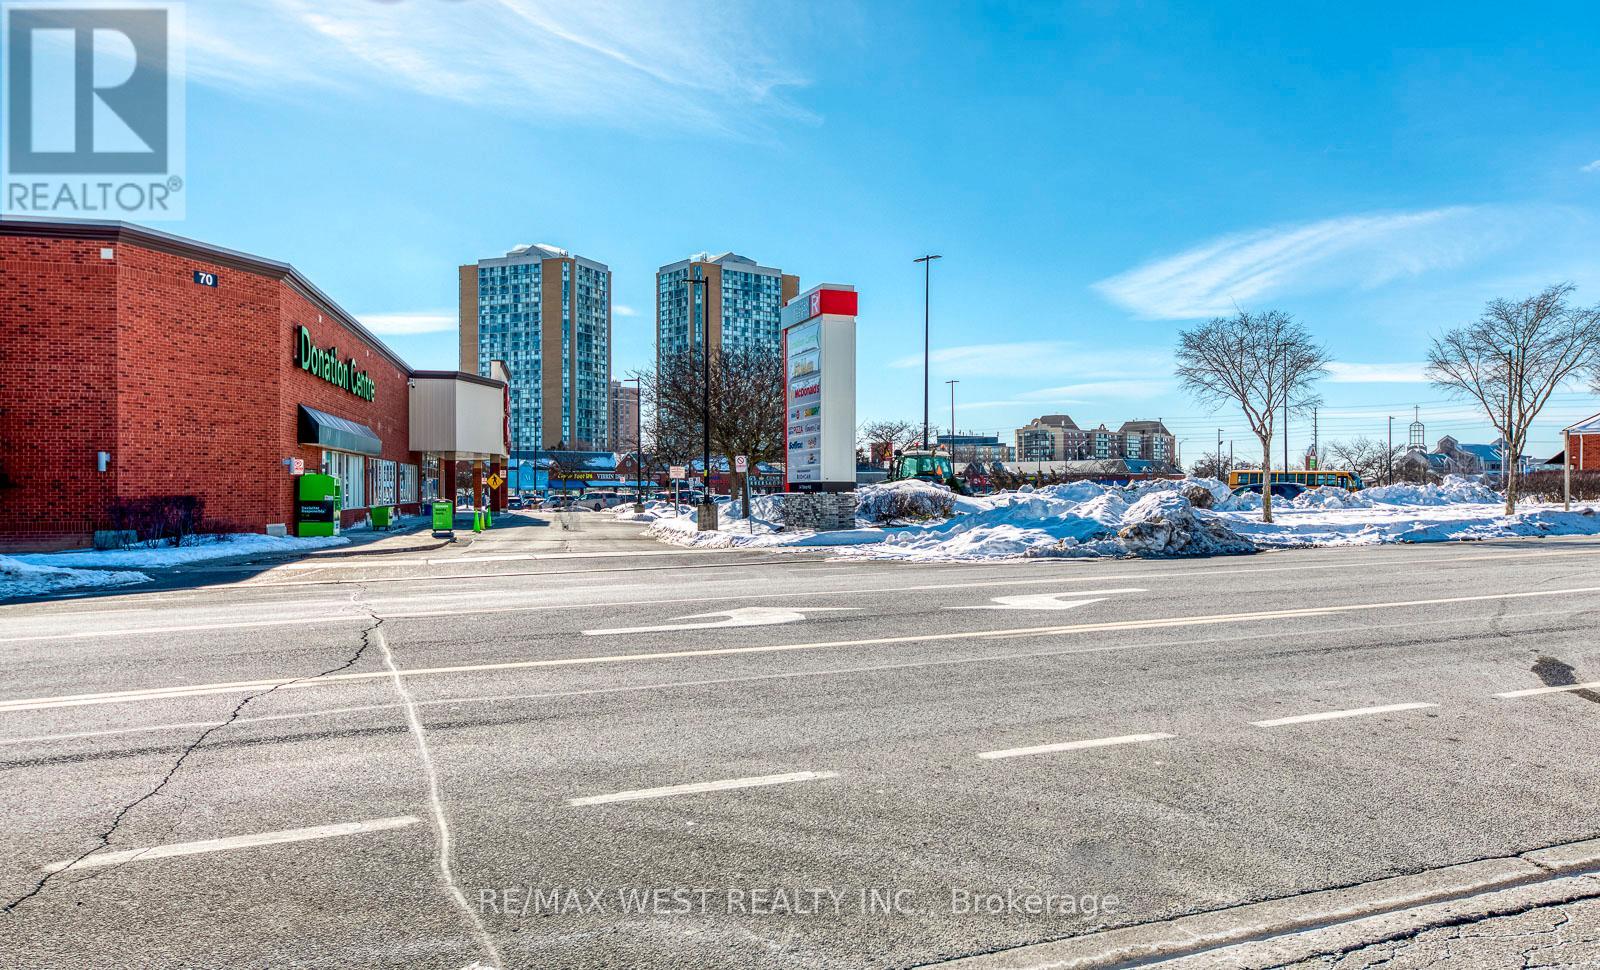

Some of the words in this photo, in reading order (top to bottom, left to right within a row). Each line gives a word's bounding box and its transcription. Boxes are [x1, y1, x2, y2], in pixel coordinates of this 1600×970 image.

[199, 273, 214, 286] 70
[301, 325, 349, 391] Donation
[351, 357, 375, 402] Centre
[795, 384, 820, 399] McDonald's
